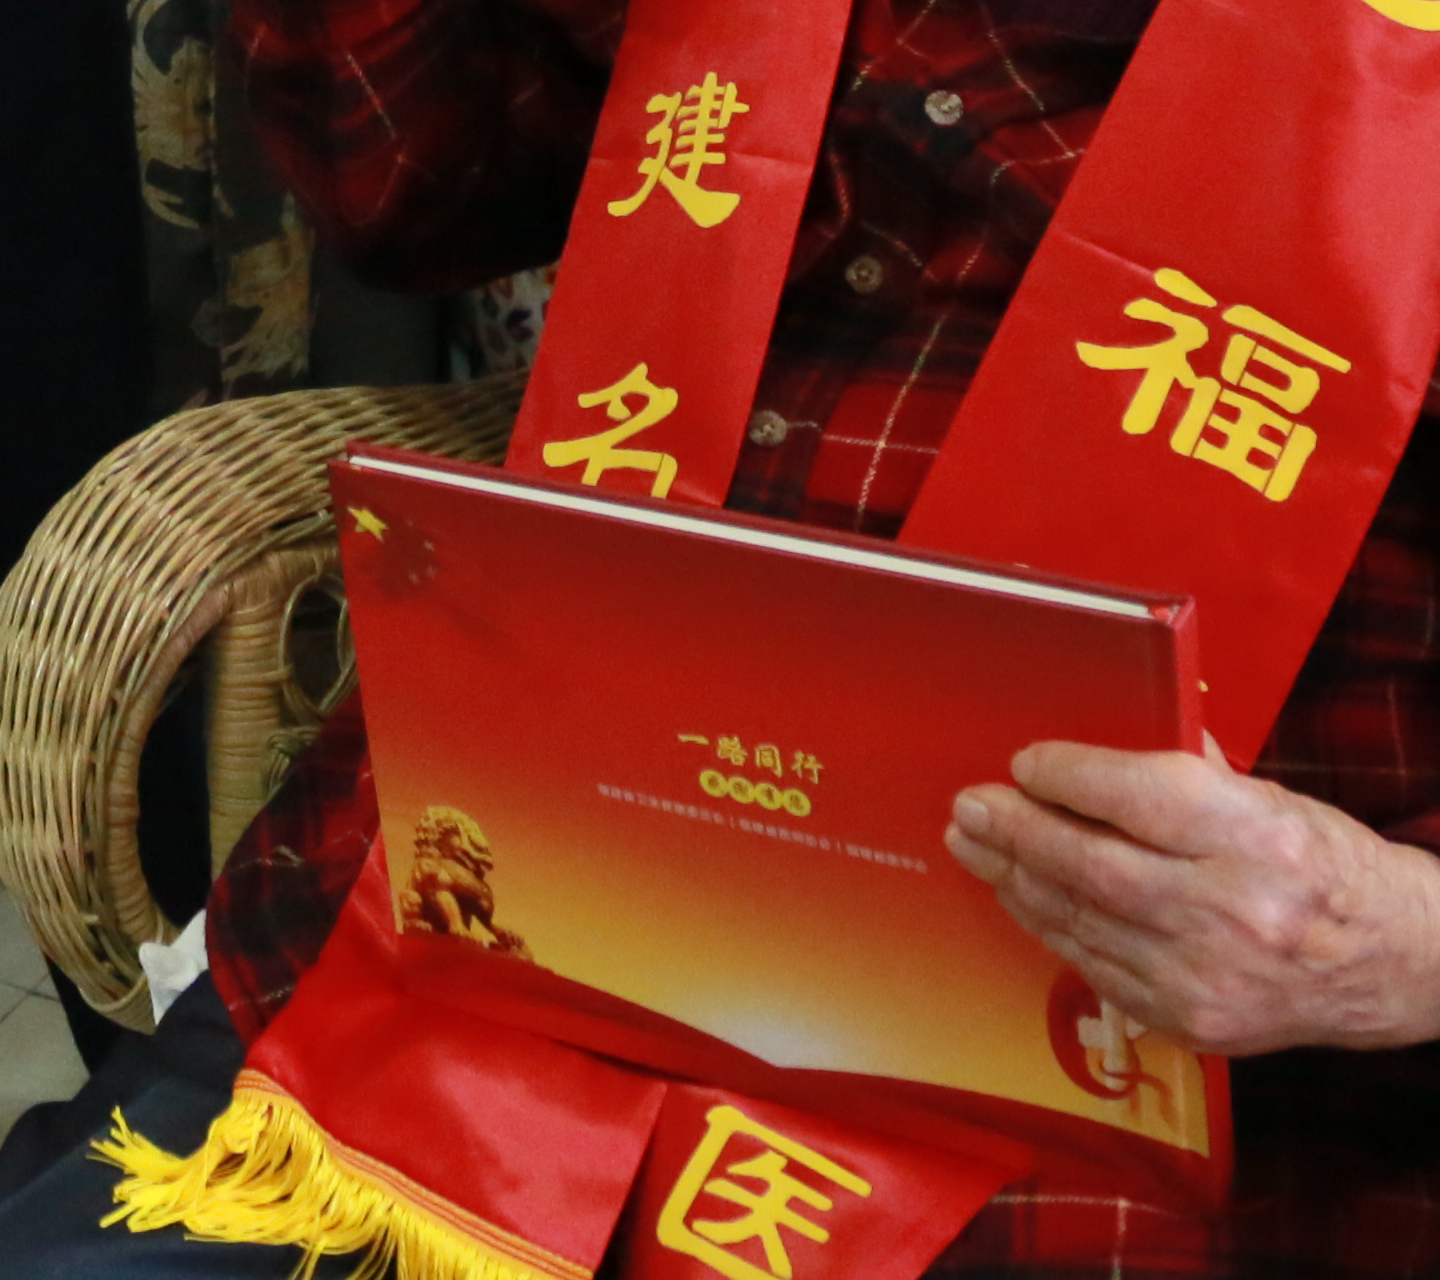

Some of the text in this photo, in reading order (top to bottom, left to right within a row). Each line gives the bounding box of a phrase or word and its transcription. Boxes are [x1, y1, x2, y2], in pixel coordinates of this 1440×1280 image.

[1075, 267, 1352, 503] 福
[677, 734, 824, 784] 一路同行
[656, 1104, 873, 1280] 医
